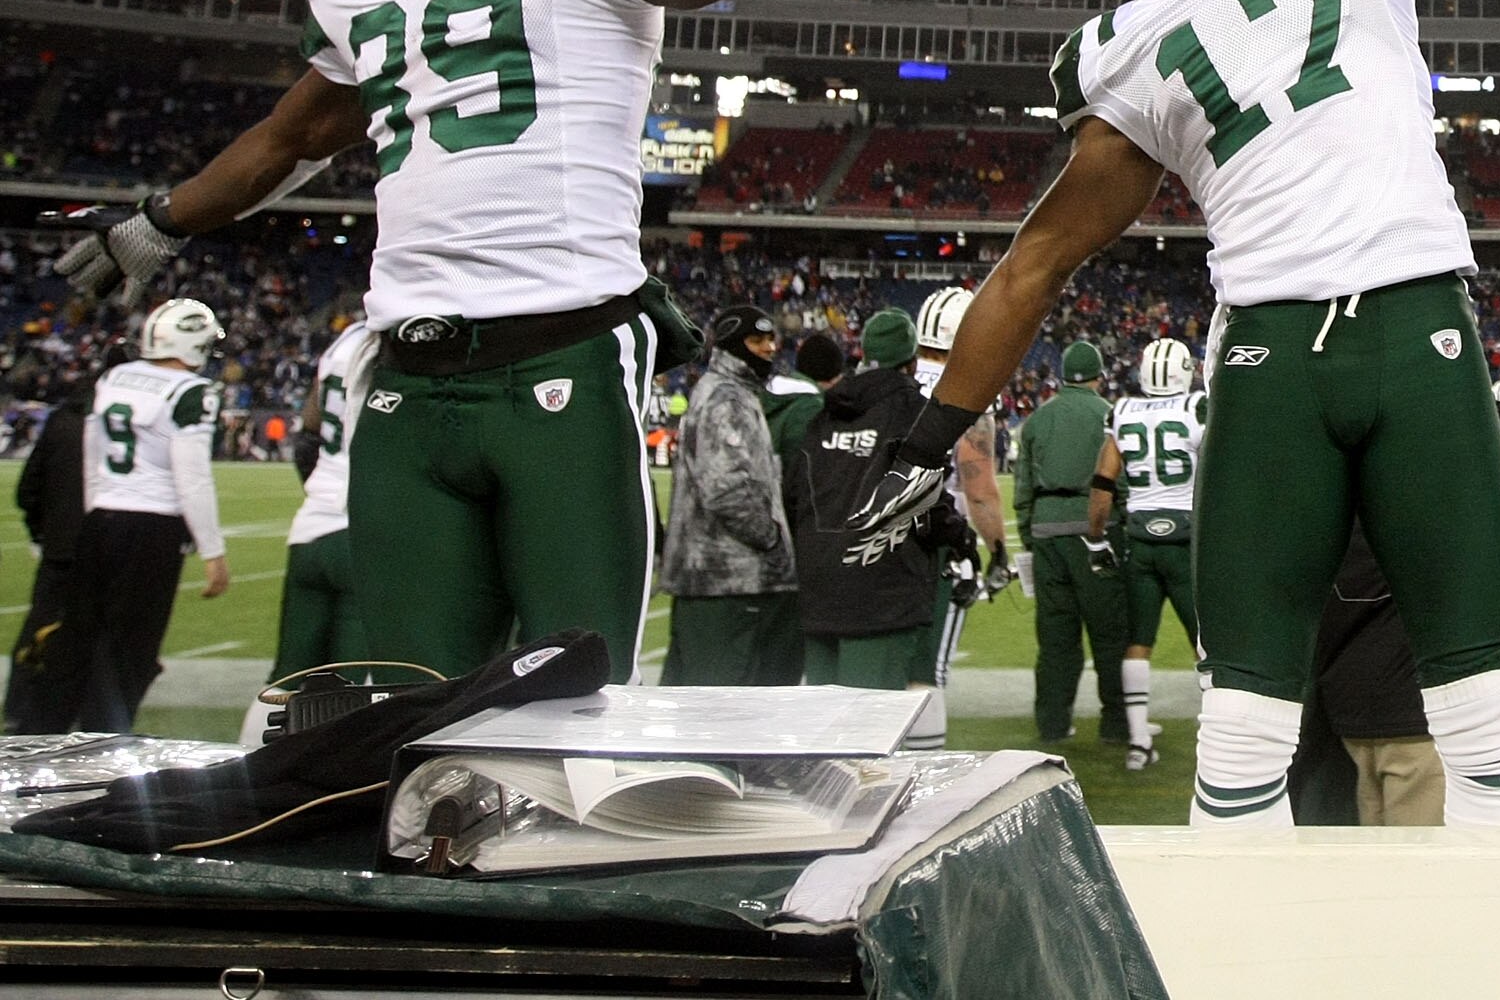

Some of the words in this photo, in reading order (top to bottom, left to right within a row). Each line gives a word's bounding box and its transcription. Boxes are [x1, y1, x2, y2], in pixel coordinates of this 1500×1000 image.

[103, 402, 136, 475] 9
[821, 429, 878, 450] JETS
[1117, 420, 1193, 486] 26
